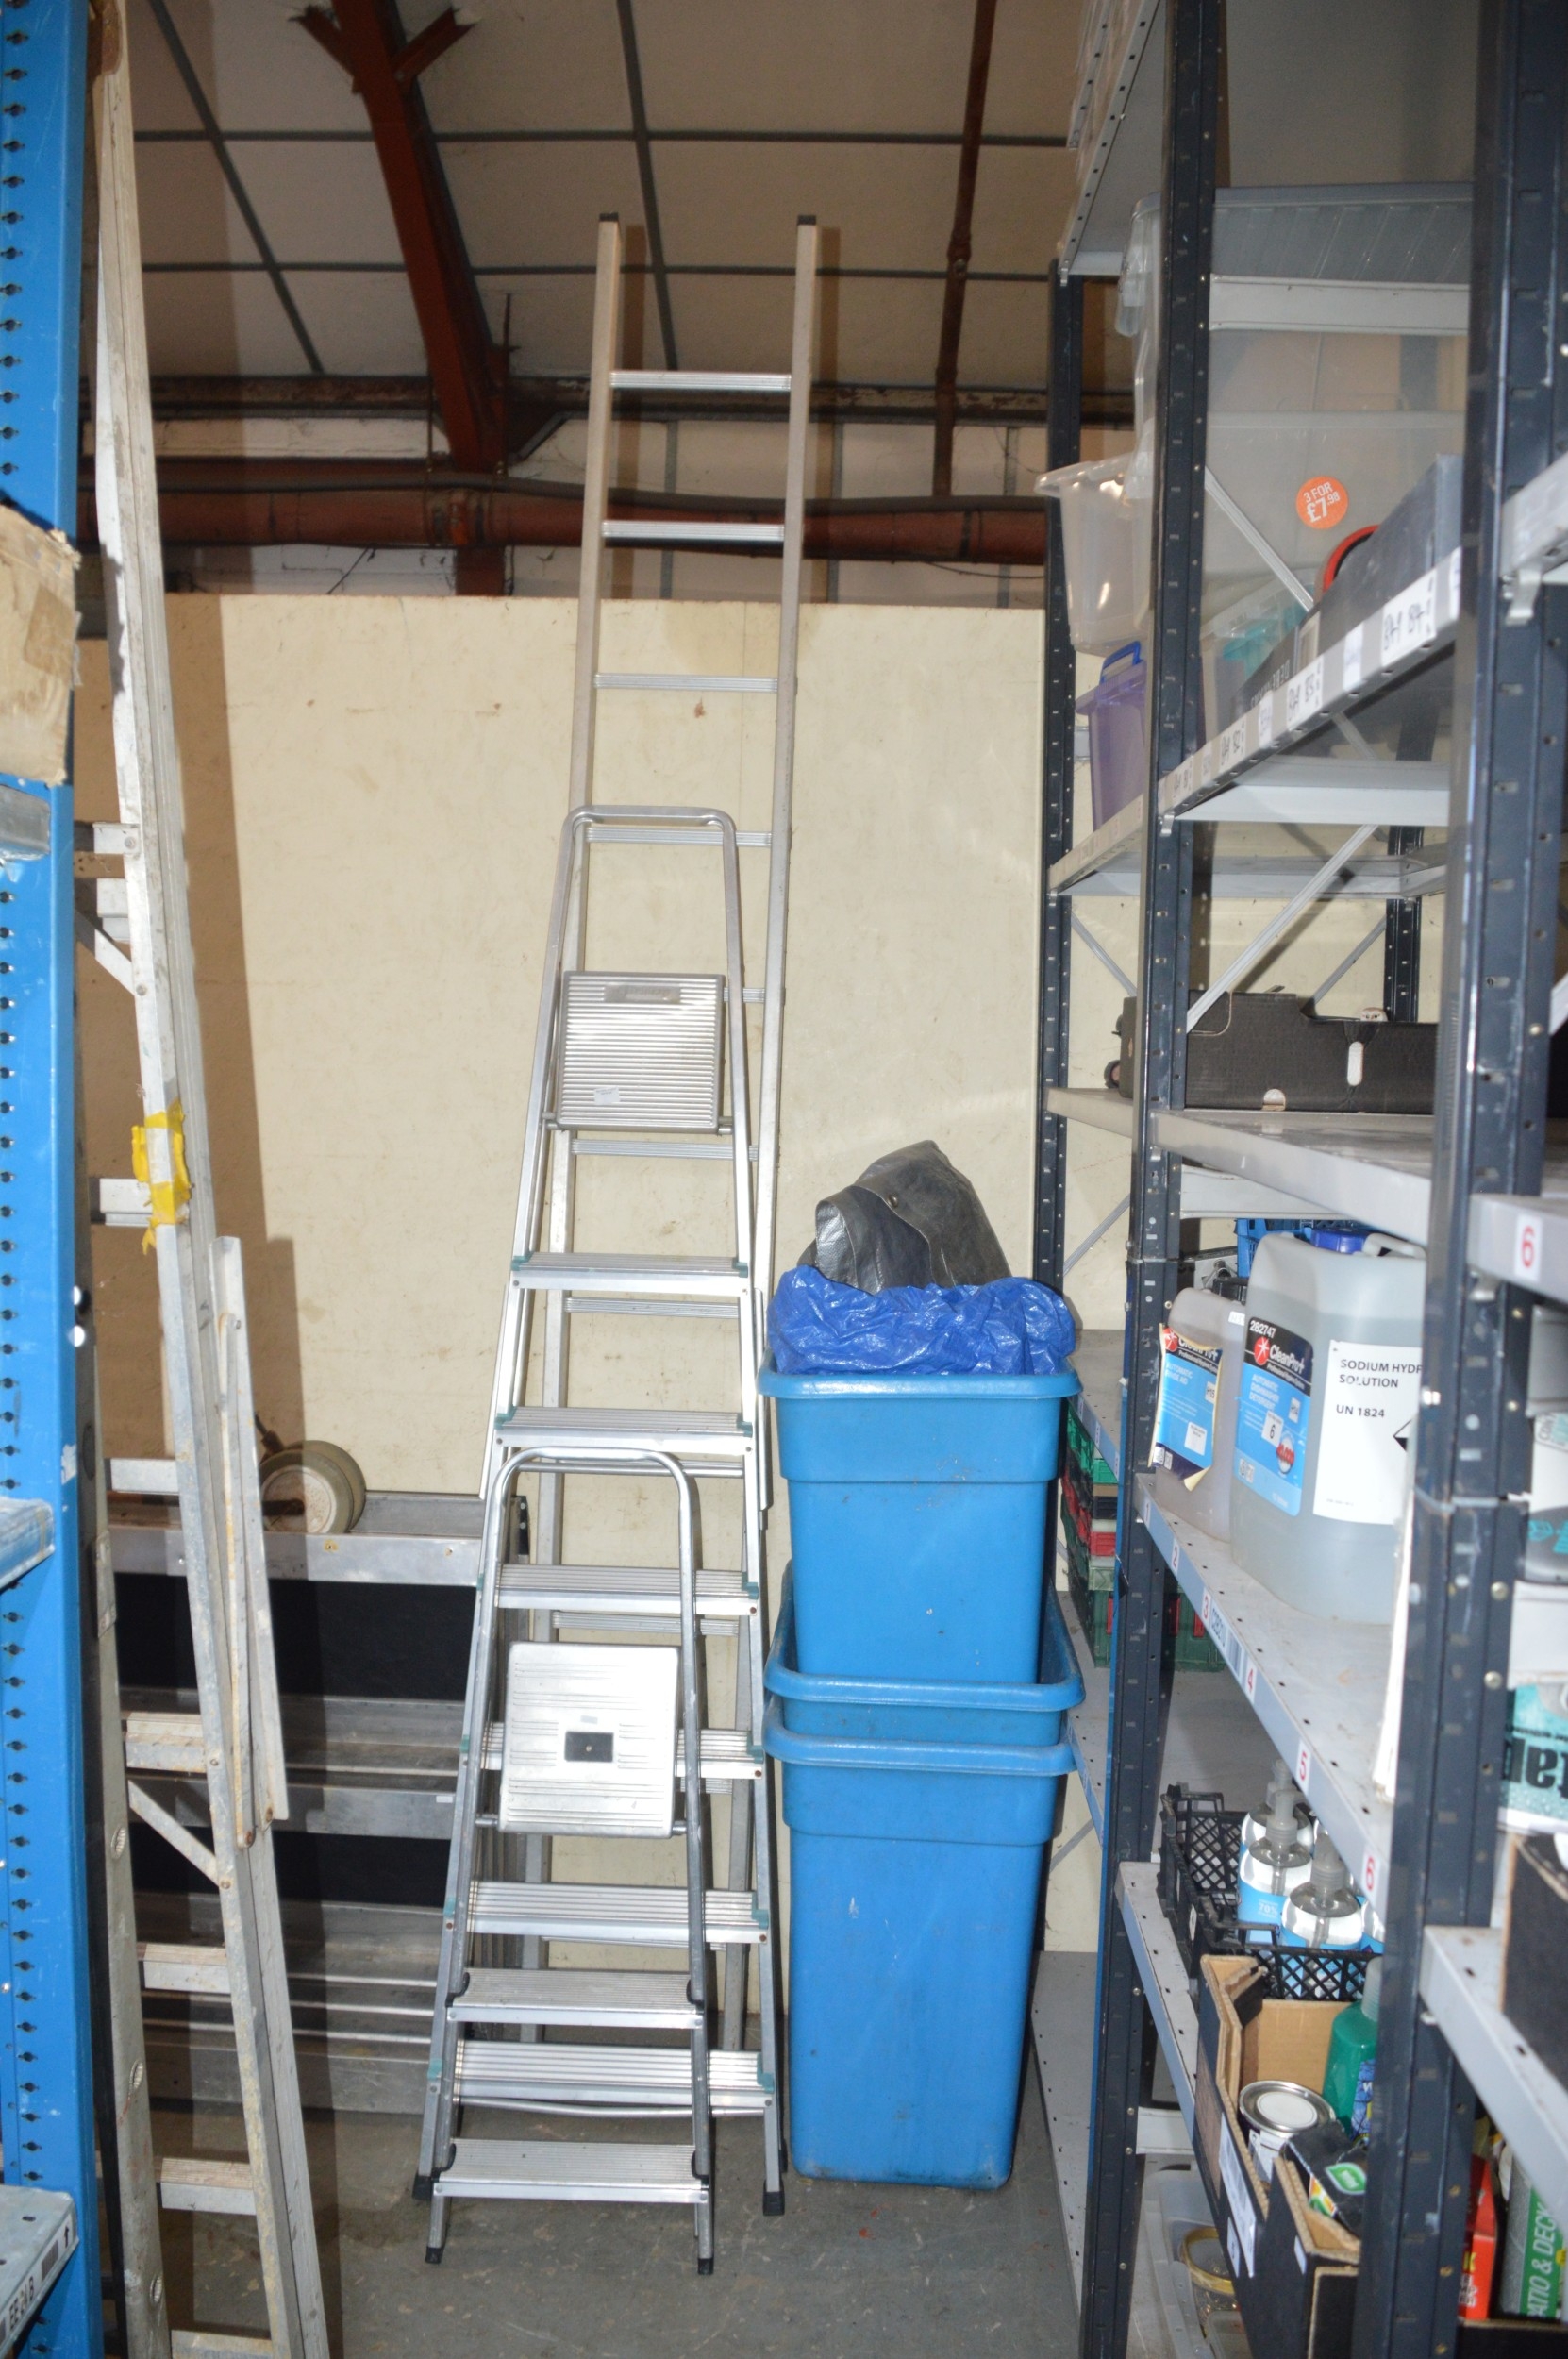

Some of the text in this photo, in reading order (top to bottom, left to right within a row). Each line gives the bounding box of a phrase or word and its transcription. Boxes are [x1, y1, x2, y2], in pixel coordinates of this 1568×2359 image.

[1304, 481, 1333, 503] 3 FOR
[1521, 1225, 1535, 1268] 6
[1249, 1320, 1276, 1339] 282747
[1340, 1359, 1389, 1373] SODIUM
[1339, 1374, 1399, 1388] SOLUTION
[1336, 1404, 1385, 1417] UN 1824
[1172, 1546, 1178, 1568] 2
[1203, 1596, 1209, 1620] 3
[1246, 1667, 1254, 1693] 4
[1299, 1750, 1308, 1782] 5
[1365, 1856, 1375, 1891] 6
[1532, 2259, 1553, 2275] &
